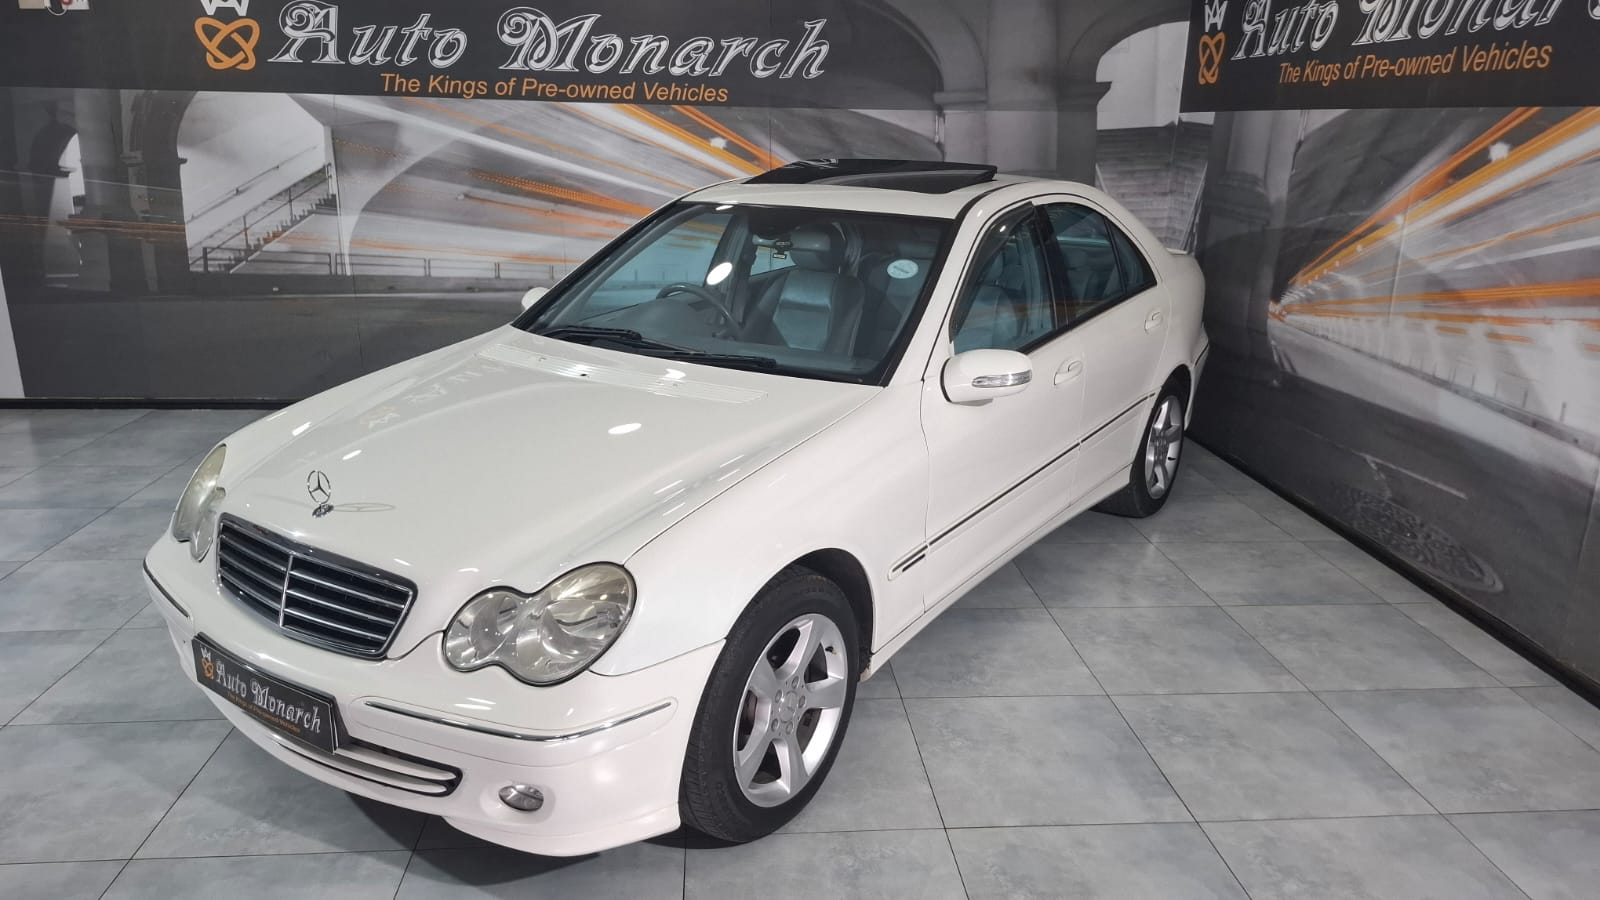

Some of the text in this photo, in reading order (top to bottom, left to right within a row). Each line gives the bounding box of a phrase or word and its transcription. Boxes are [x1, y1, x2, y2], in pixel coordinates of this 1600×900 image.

[267, 0, 829, 79] Auto Monarch
[1230, 0, 1339, 61] Auto
[380, 73, 729, 102] The Kings of Pre-owned Vehicles
[1279, 40, 1553, 87] The Kings of Pre-owned Vehicles
[216, 658, 247, 698] Auto
[251, 679, 321, 733] Monarch
